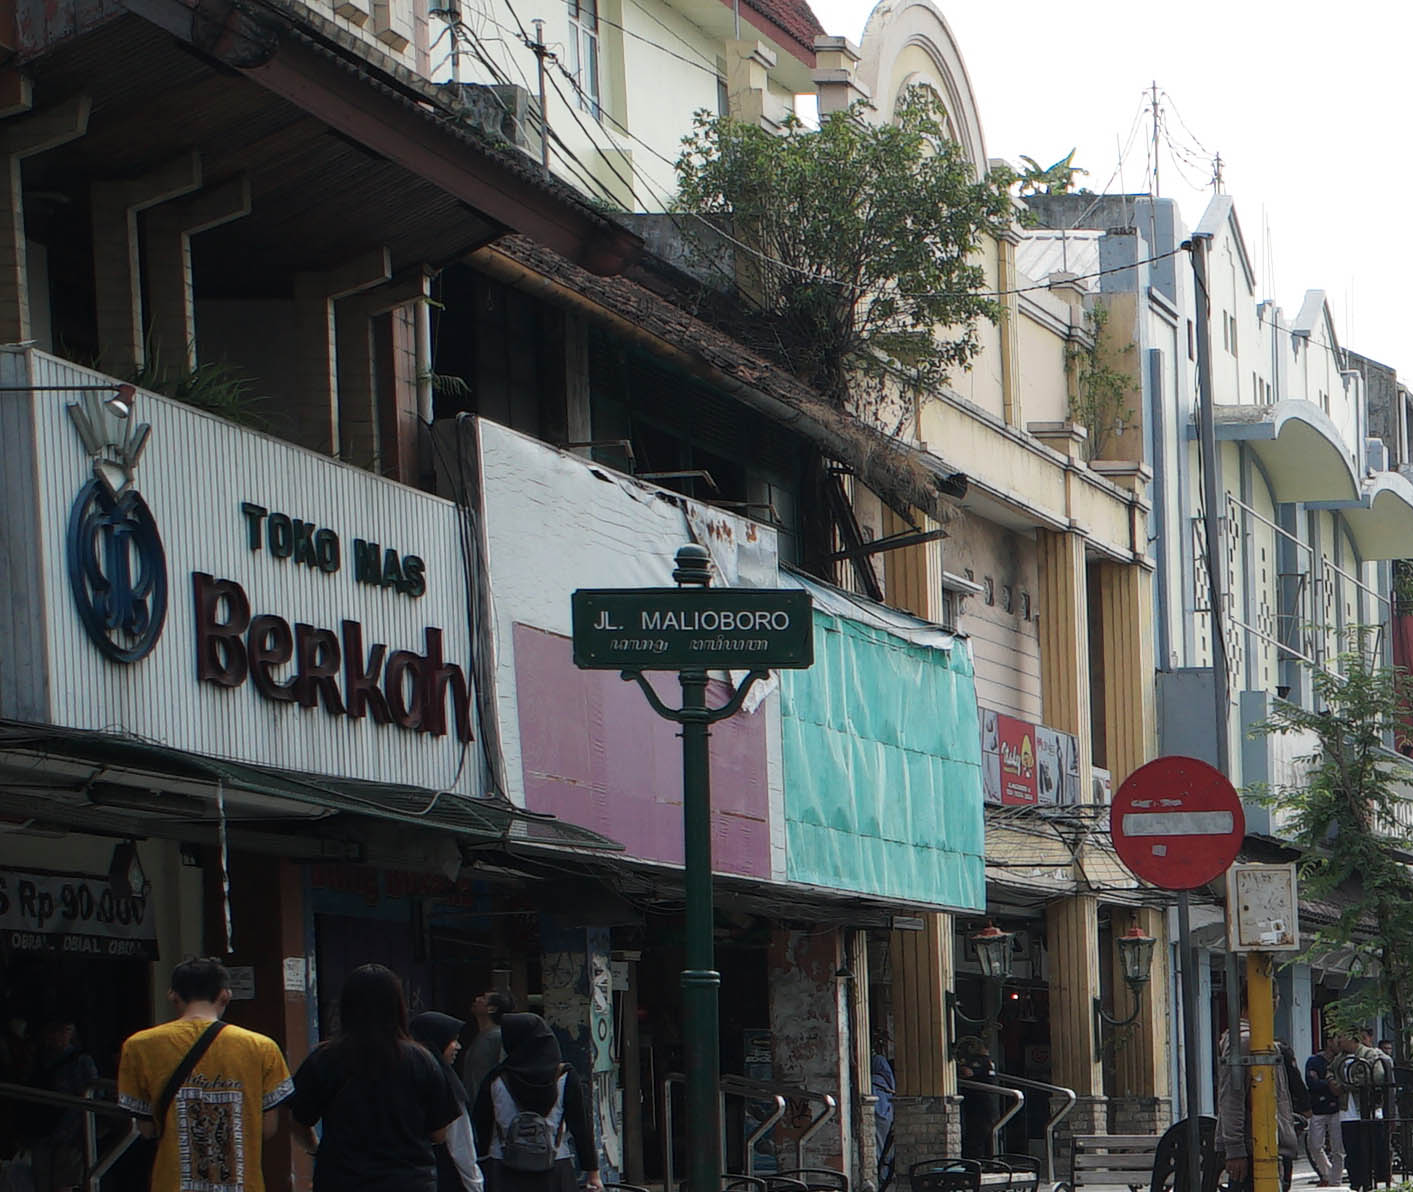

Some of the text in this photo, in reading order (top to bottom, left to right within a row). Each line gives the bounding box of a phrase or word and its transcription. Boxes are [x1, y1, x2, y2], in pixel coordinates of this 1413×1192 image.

[241, 501, 426, 598] TOKO MAS
[593, 610, 790, 631] JL. MALIOBORO
[18, 879, 54, 928] Rp
